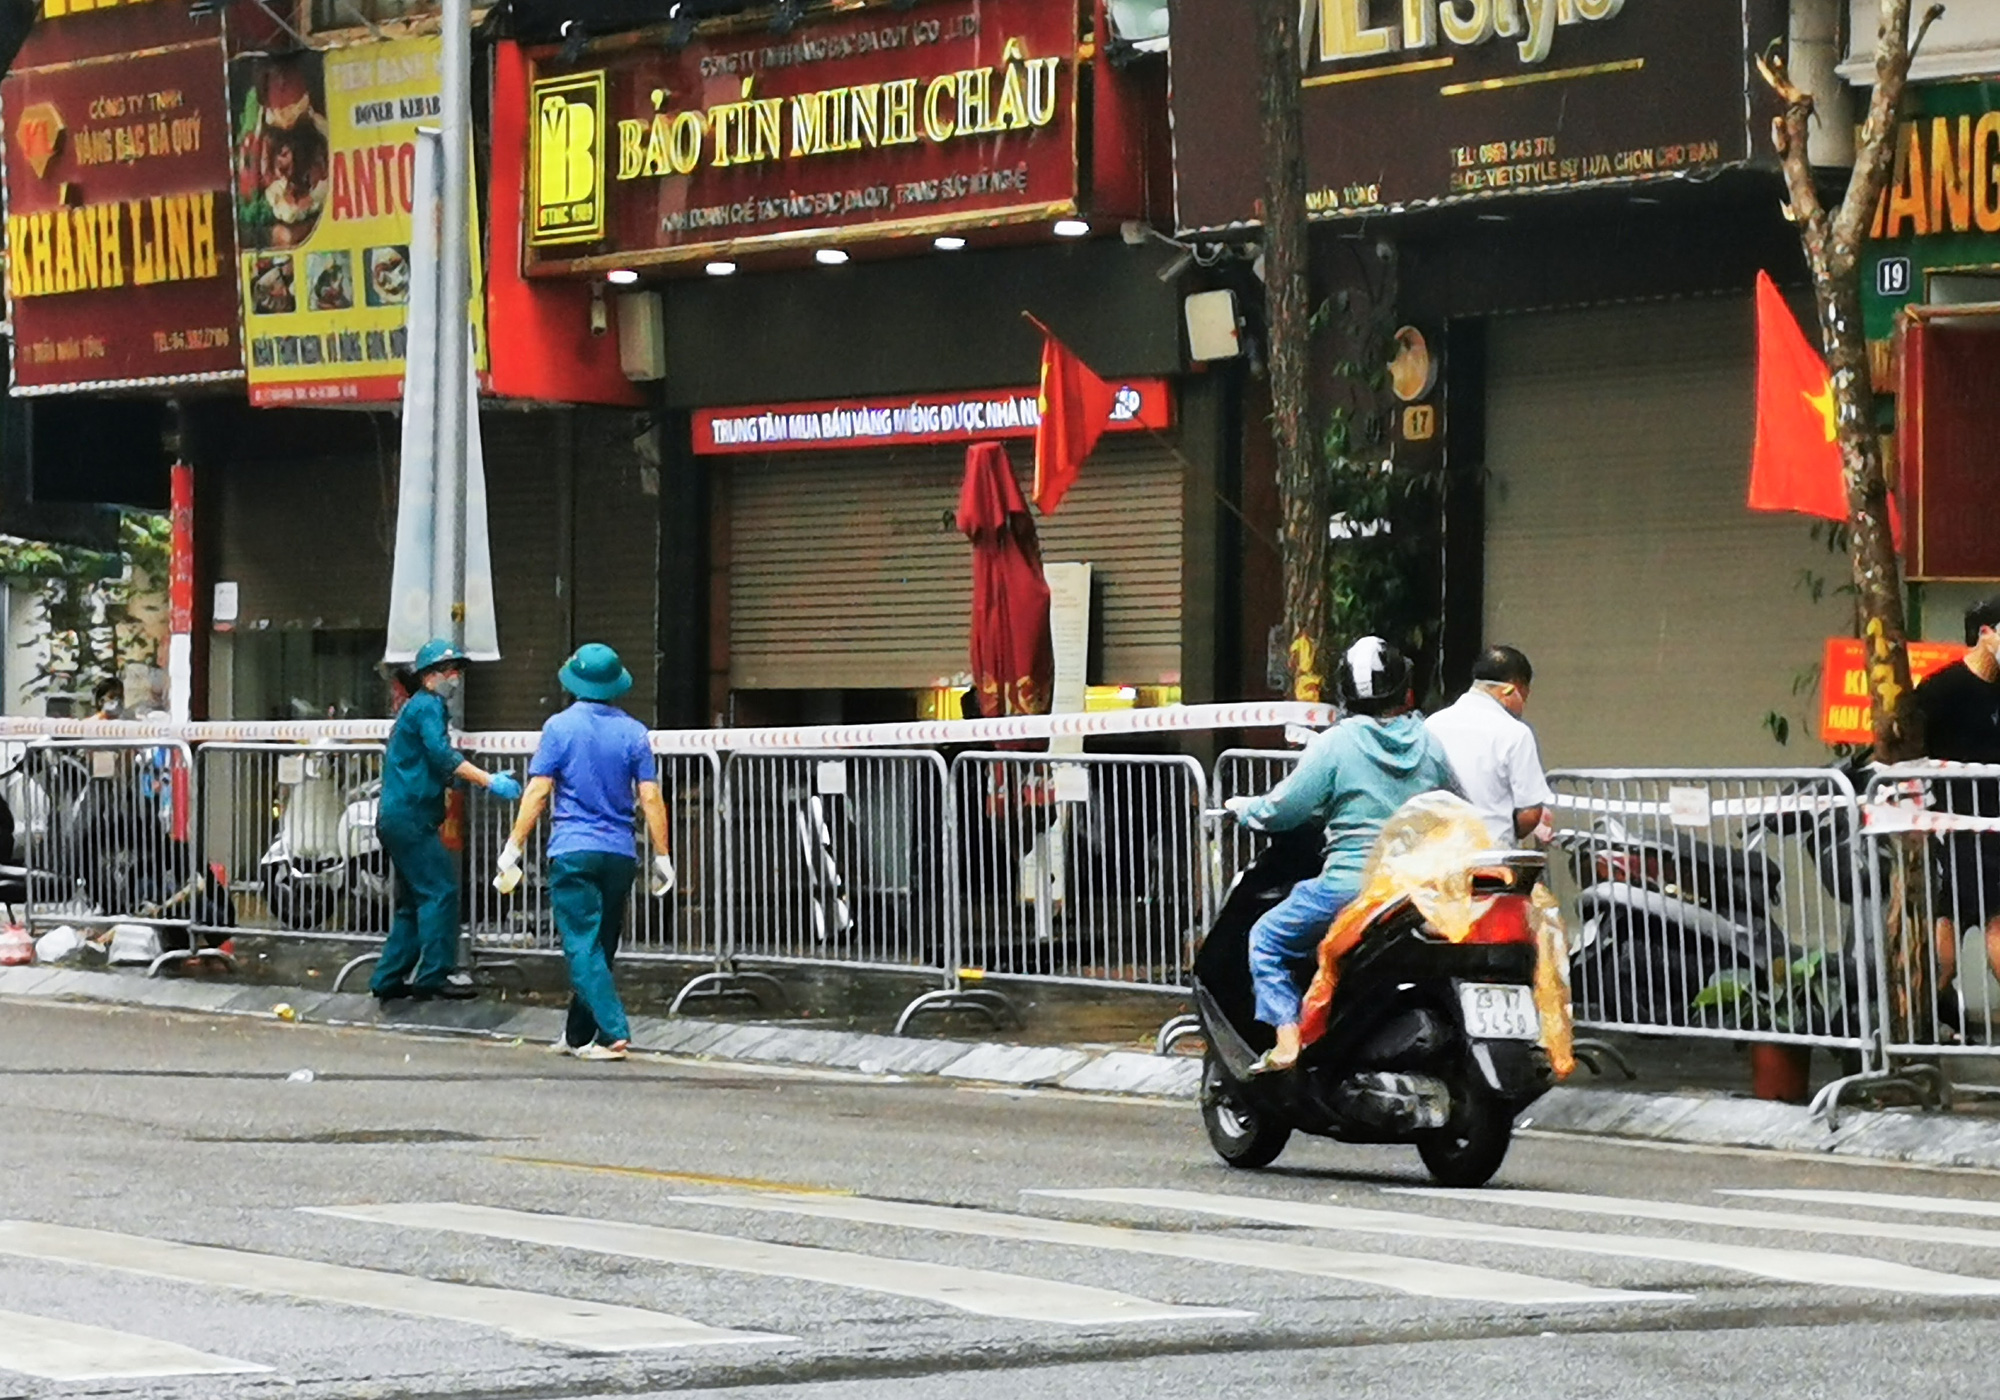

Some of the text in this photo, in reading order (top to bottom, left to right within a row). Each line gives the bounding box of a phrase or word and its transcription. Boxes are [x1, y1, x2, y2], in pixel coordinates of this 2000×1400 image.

[617, 36, 1060, 181] BẢO TÍN MINH CHÂU
[130, 191, 218, 286] LINH
[1883, 262, 1903, 292] 19
[711, 417, 758, 444] TRUNG
[758, 411, 787, 442] TÂM
[788, 411, 821, 440] MUA
[821, 406, 851, 438] BÁN
[852, 405, 891, 436] VÀNG
[986, 395, 1020, 429] NHÀ
[1411, 410, 1429, 435] 17
